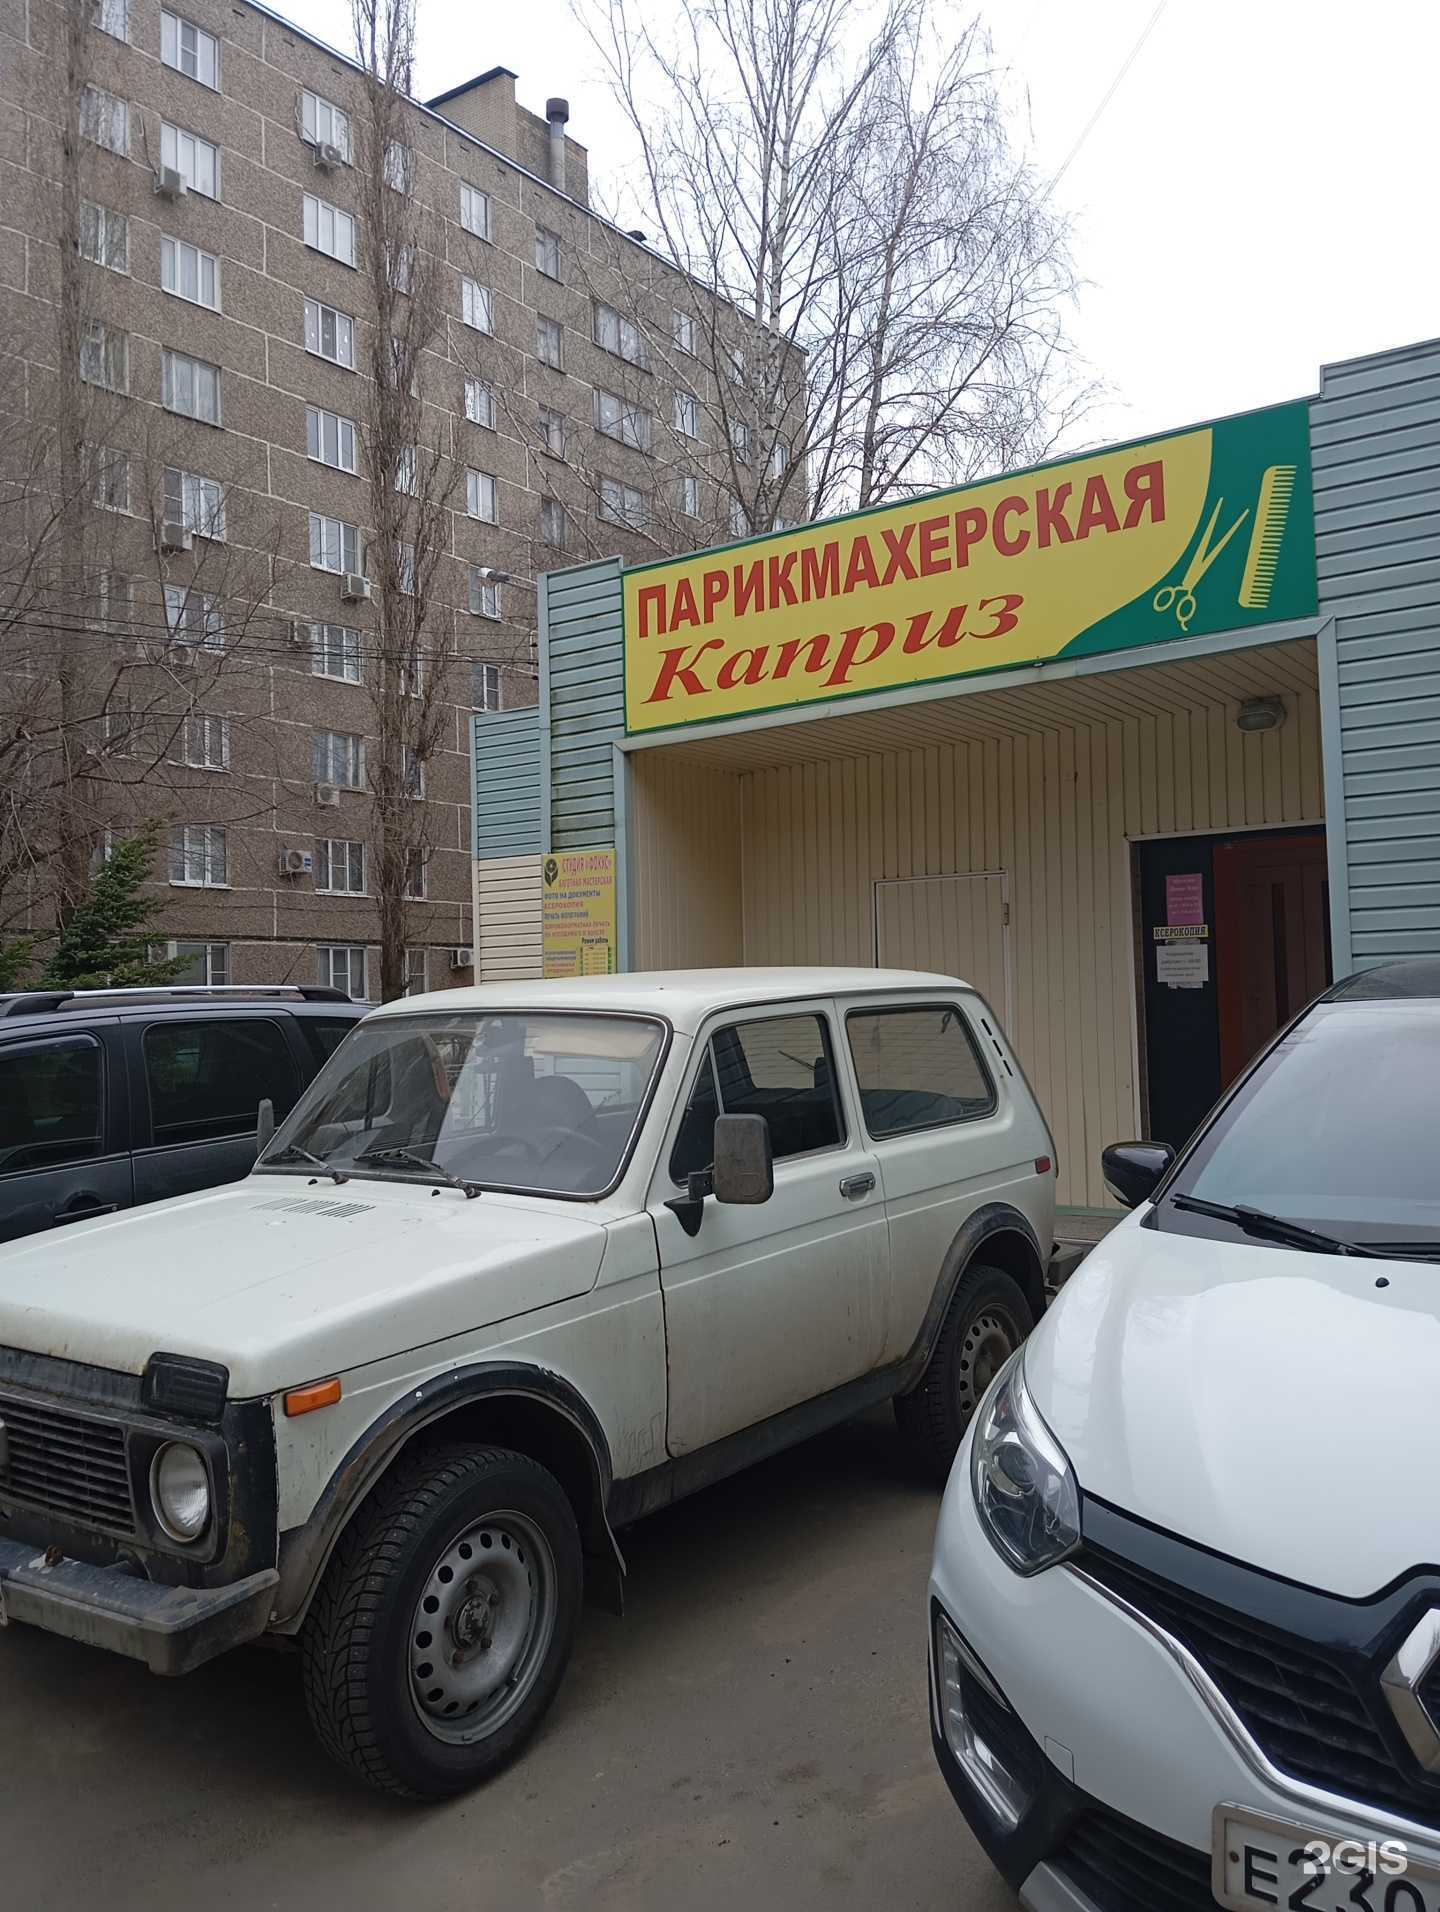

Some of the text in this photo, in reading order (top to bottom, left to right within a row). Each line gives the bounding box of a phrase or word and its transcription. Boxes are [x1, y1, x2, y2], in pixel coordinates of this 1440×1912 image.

[637, 460, 1166, 639] ПАРИКМАХЕРСКАЯ
[640, 593, 1025, 705] Каприз
[1155, 926, 1205, 938] КСЕРОКОПИЯ
